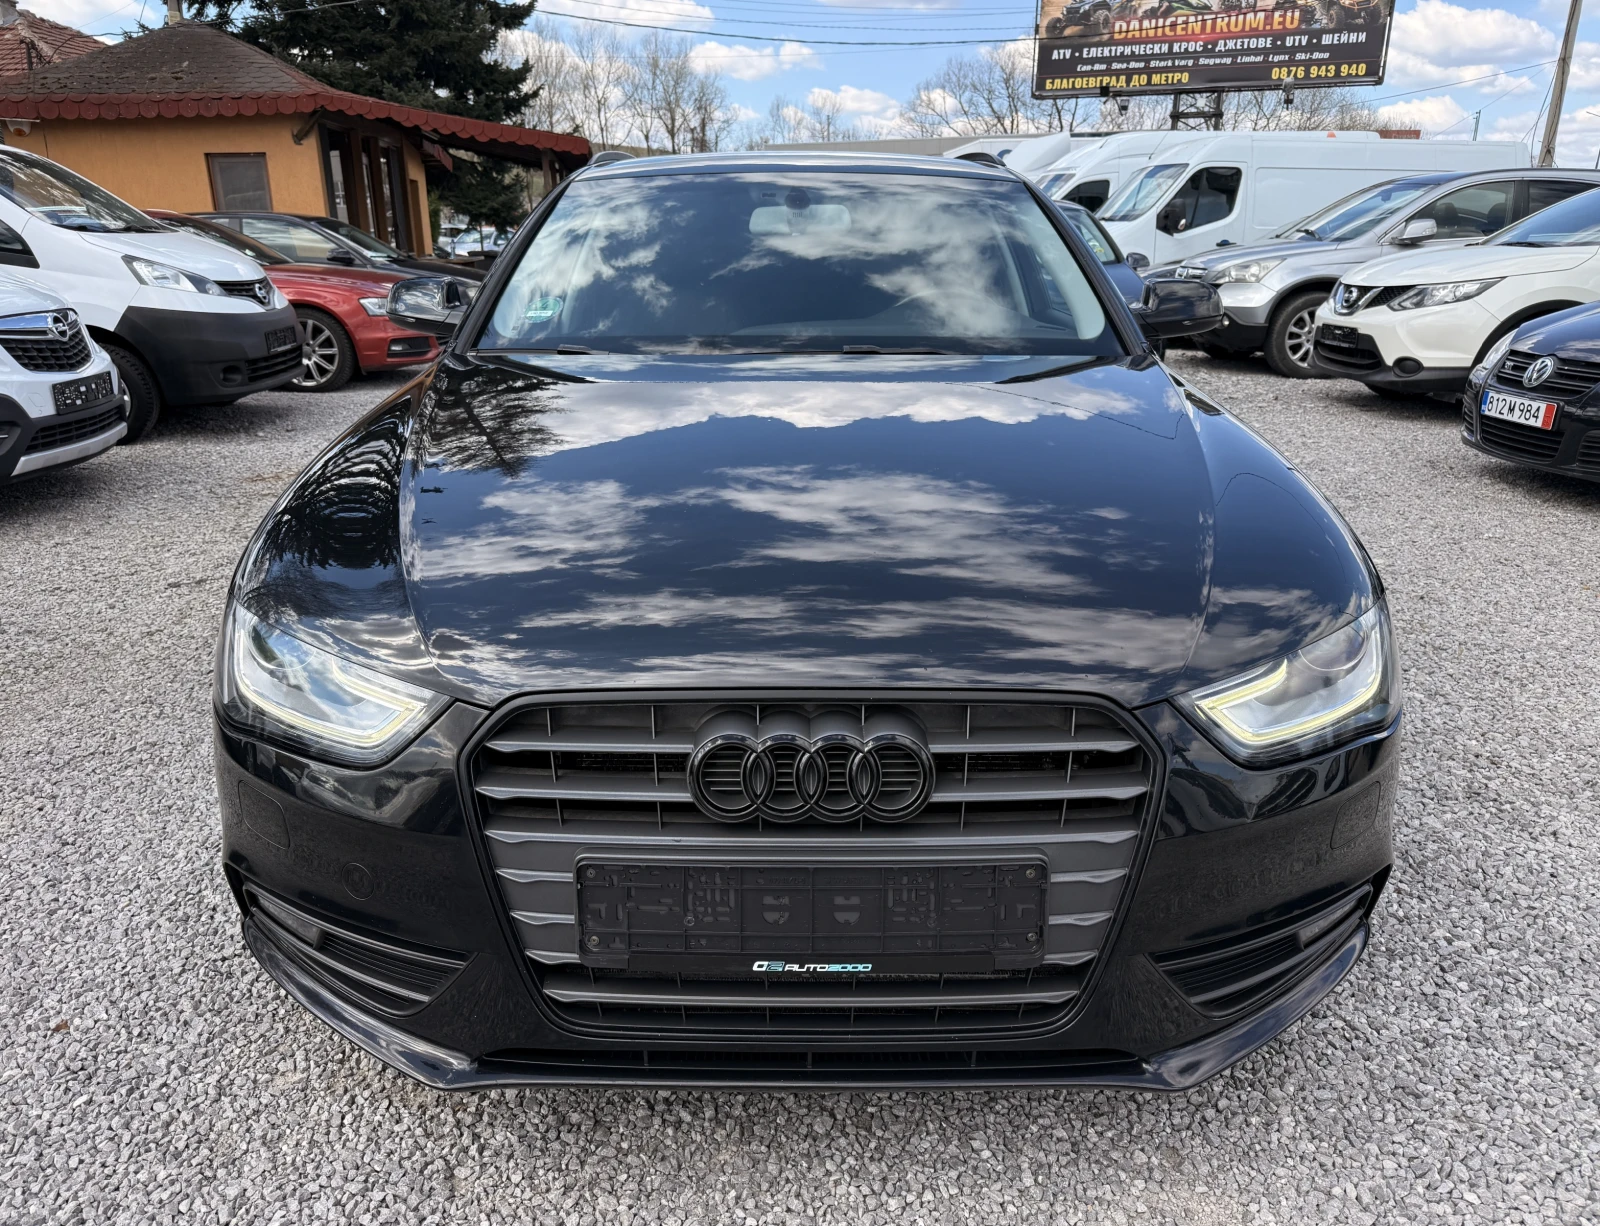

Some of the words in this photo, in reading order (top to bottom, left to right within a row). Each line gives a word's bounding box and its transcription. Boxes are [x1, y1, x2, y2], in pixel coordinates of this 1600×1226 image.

[1113, 9, 1301, 40] DANICENTRUM.EU
[1052, 49, 1072, 60] ATV
[1083, 44, 1169, 58] ЕЛЕКТРИЧЕСКИ
[1172, 41, 1204, 53] КРОС
[1215, 37, 1273, 52] ДЖЕТОВЕ
[1285, 35, 1309, 47] UTV
[1321, 31, 1367, 45] ШЕЙНИ
[1149, 60, 1173, 68] Stark
[1174, 59, 1194, 67] Varg
[1199, 56, 1232, 66] Segway
[1237, 54, 1264, 63] Linhai
[1268, 53, 1290, 62] Lynx
[1295, 52, 1330, 60] Ski-Doo
[1271, 66, 1305, 80] 0876
[1309, 64, 1336, 78] 943
[1340, 63, 1367, 76] 940
[1045, 75, 1127, 90] БЛАГОЕВГРАД
[1129, 74, 1148, 88] ДО
[1151, 72, 1190, 85] МЕТРО
